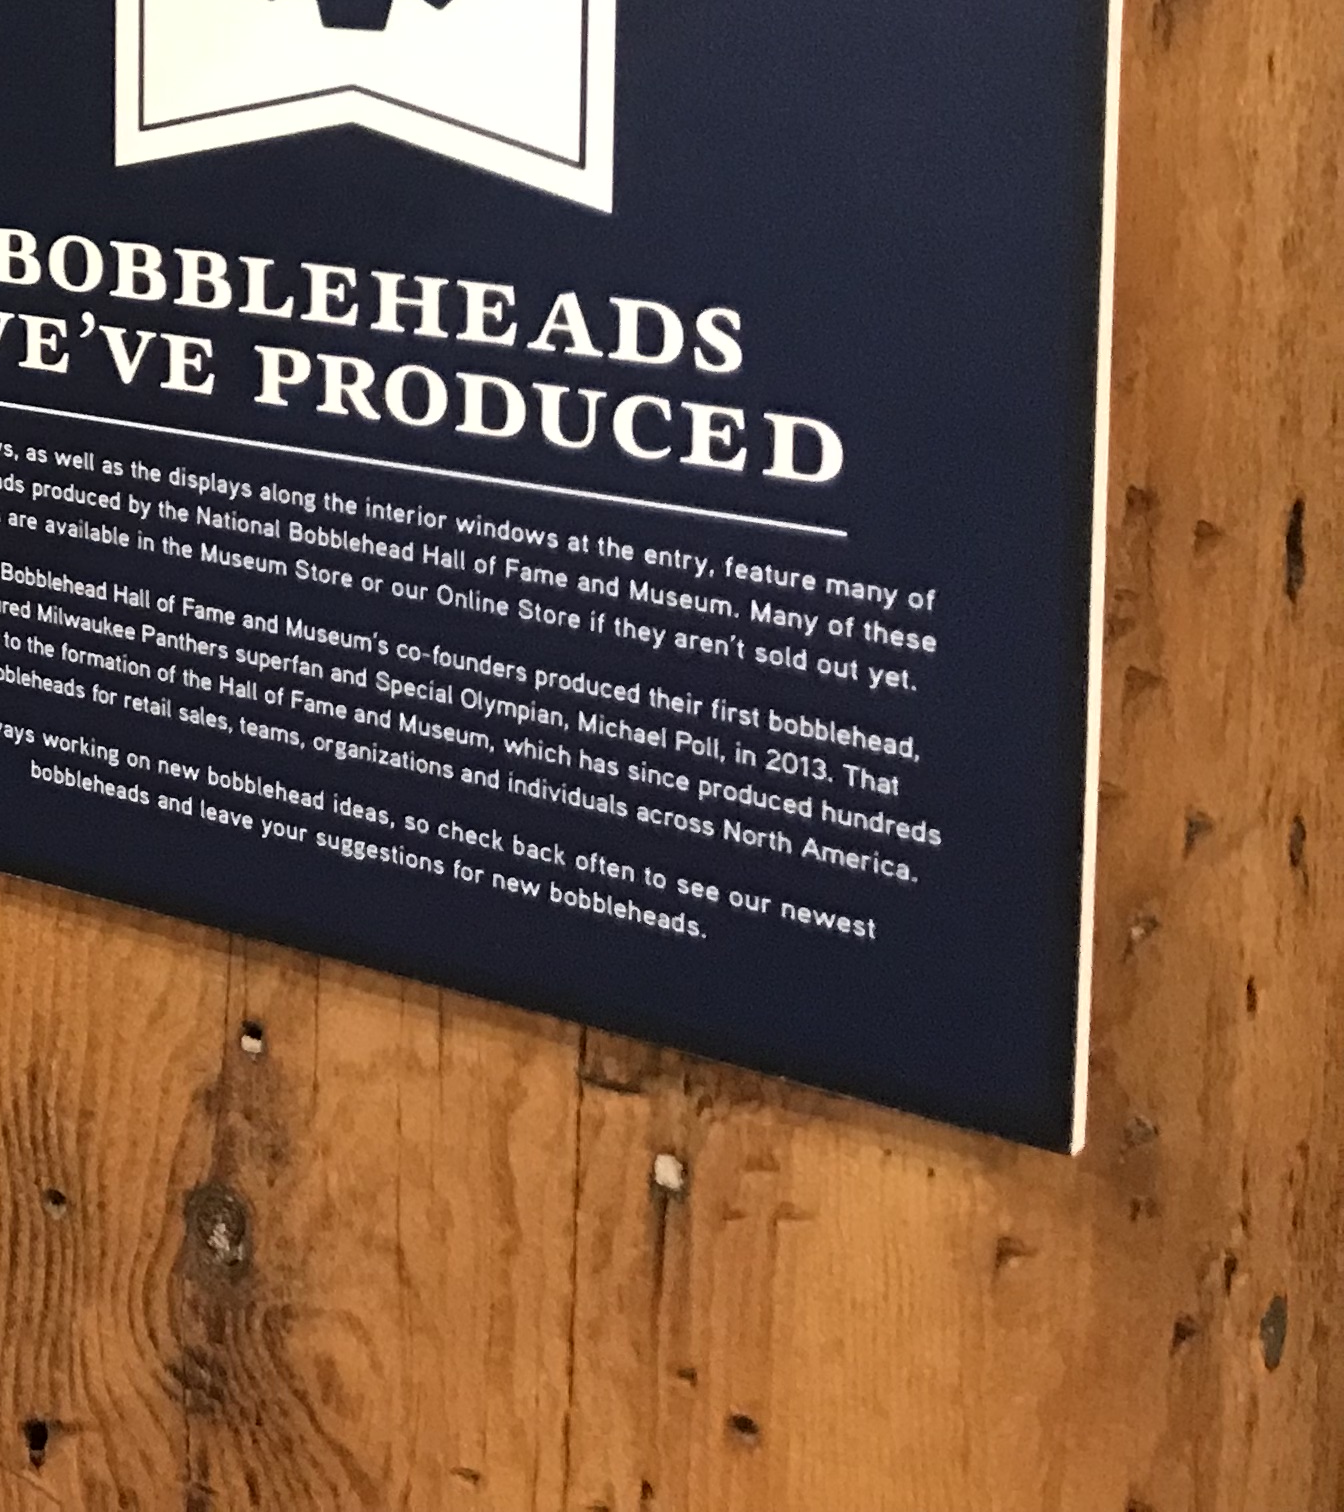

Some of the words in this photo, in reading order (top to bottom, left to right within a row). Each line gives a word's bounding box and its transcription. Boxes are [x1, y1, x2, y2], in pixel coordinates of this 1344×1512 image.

[253, 344, 845, 486] PRODUCED
[7, 512, 38, 531] are
[44, 518, 130, 548] available
[137, 529, 155, 552] in
[161, 535, 193, 559] the
[200, 542, 288, 577] Museum
[294, 558, 353, 589] Store
[361, 576, 384, 593] or
[391, 581, 429, 601] our
[436, 583, 510, 617] Online
[518, 598, 581, 630] Store
[589, 609, 606, 634] if
[613, 616, 667, 650] they
[674, 631, 745, 660] aren't
[754, 645, 808, 672] sold
[816, 657, 859, 681] out
[868, 666, 917, 692] yet.
[25, 447, 48, 464] as
[53, 451, 95, 472] well
[101, 459, 124, 477] as
[130, 460, 162, 483] the
[168, 466, 253, 501] displays
[259, 482, 317, 513] along
[323, 492, 358, 516] the
[365, 496, 448, 530] interior
[455, 514, 559, 549] windows
[567, 534, 589, 554] at
[597, 536, 634, 562] the
[644, 548, 715, 579] entry,
[724, 555, 817, 591] feature
[825, 578, 899, 611] many
[907, 588, 937, 611] of
[32, 482, 121, 511] produced
[128, 493, 152, 520] by
[157, 499, 190, 523] the
[196, 505, 281, 539] National
[288, 521, 414, 562] Bobblehead
[422, 543, 466, 571] Hall
[473, 555, 497, 576] of
[505, 557, 569, 588] Fame
[576, 575, 620, 598] and
[629, 578, 740, 619] Museum.
[750, 599, 819, 637] Many
[827, 616, 856, 638] of
[863, 620, 937, 653] these
[0, 561, 108, 601] Bobblehead
[113, 583, 151, 609] Hall
[156, 594, 176, 614] of
[182, 596, 236, 626] Fame
[241, 613, 279, 635] and
[286, 616, 389, 656] Museum's
[396, 643, 528, 683] co-founders
[534, 668, 641, 705] produced
[648, 686, 704, 716] their
[711, 698, 760, 729] first
[768, 708, 920, 763] bobblehead,
[3, 631, 22, 651] to
[26, 635, 55, 658] the
[61, 641, 151, 679] formation
[156, 664, 177, 684] of
[182, 668, 213, 692] the
[218, 674, 258, 701] Hall
[264, 686, 285, 706] of
[290, 689, 348, 720] Fame
[353, 707, 392, 729] and
[398, 712, 495, 754] Museum,
[503, 736, 572, 768] which
[578, 748, 620, 777] has
[627, 760, 690, 792] since
[698, 779, 813, 819] produced
[821, 799, 942, 847] hundreds
[37, 603, 136, 641] Milwaukee
[141, 623, 229, 660] Panthers
[235, 648, 324, 680] superfan
[330, 666, 368, 688] and
[375, 670, 453, 705] Special
[460, 687, 569, 732] Olympian,
[578, 710, 667, 749] Michael
[675, 730, 726, 764] Poll,
[735, 740, 757, 767] in
[765, 748, 834, 784] 2013.
[842, 763, 899, 797] That
[30, 759, 150, 805] bobbleheads
[157, 794, 193, 816] and
[200, 798, 254, 830] leave
[261, 818, 308, 842] your
[316, 831, 445, 875] suggestions
[453, 858, 485, 884] for
[492, 872, 541, 897] new
[549, 880, 707, 939] bobbleheads.
[42, 732, 120, 767] working
[126, 752, 151, 771] on
[157, 759, 201, 781] new
[207, 765, 325, 811] bobblehead
[333, 792, 395, 830] ideas,
[404, 815, 430, 835] so
[437, 819, 505, 852] check
[512, 833, 566, 866] back
[575, 851, 635, 883] often
[644, 866, 667, 890] to
[676, 878, 720, 903] see
[728, 890, 772, 914] our
[780, 902, 876, 940] newest
[92, 683, 118, 706] for
[123, 694, 172, 718] retail
[178, 705, 234, 735] sales,
[239, 716, 306, 750] teams,
[312, 736, 455, 780] organizations
[460, 767, 500, 790] and
[508, 770, 629, 818] individuals
[636, 805, 715, 837] across
[723, 818, 793, 855] North
[801, 837, 919, 883] America.
